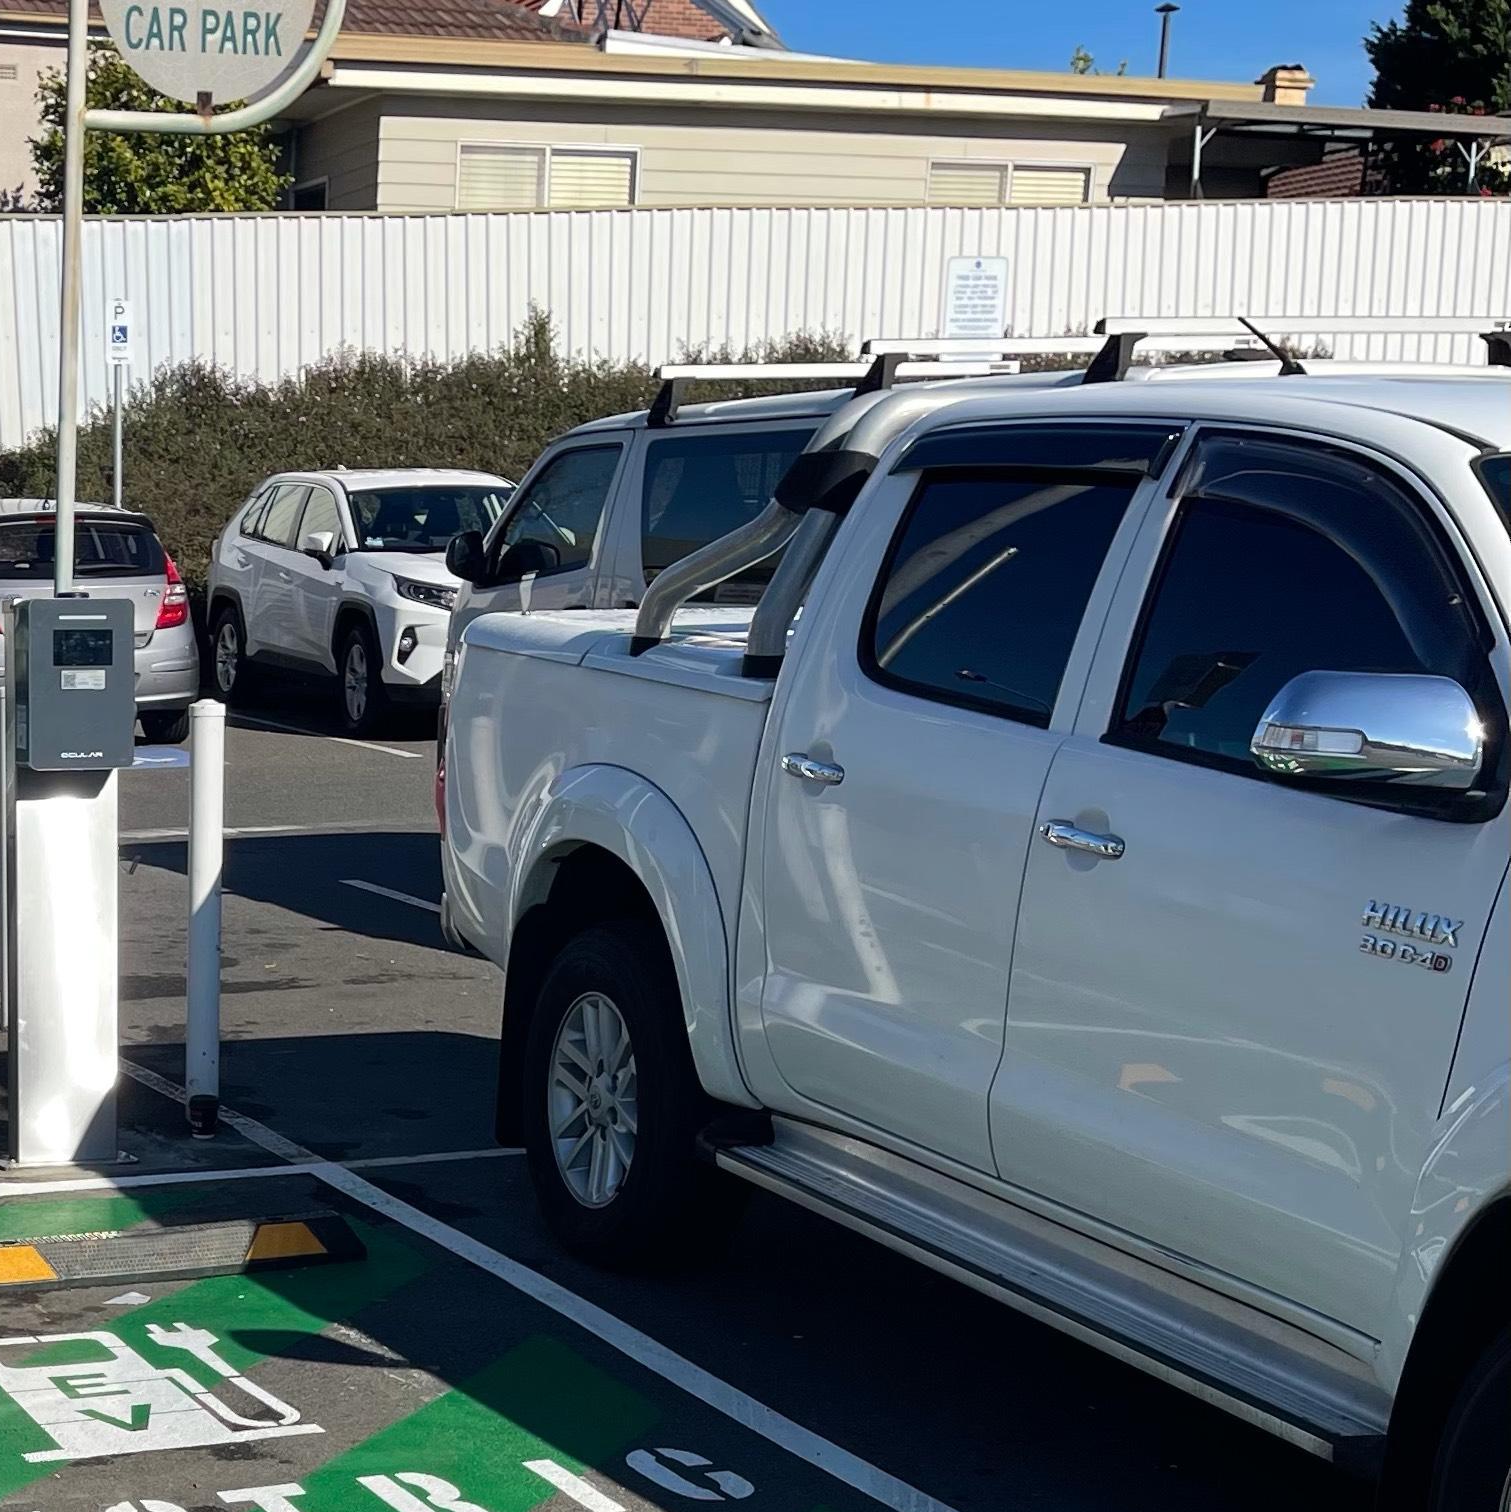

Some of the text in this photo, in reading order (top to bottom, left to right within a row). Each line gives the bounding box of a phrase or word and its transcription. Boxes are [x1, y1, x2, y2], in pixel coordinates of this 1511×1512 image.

[124, 5, 282, 56] CAR PARK
[114, 306, 125, 320] P
[1361, 899, 1465, 948] HILUX
